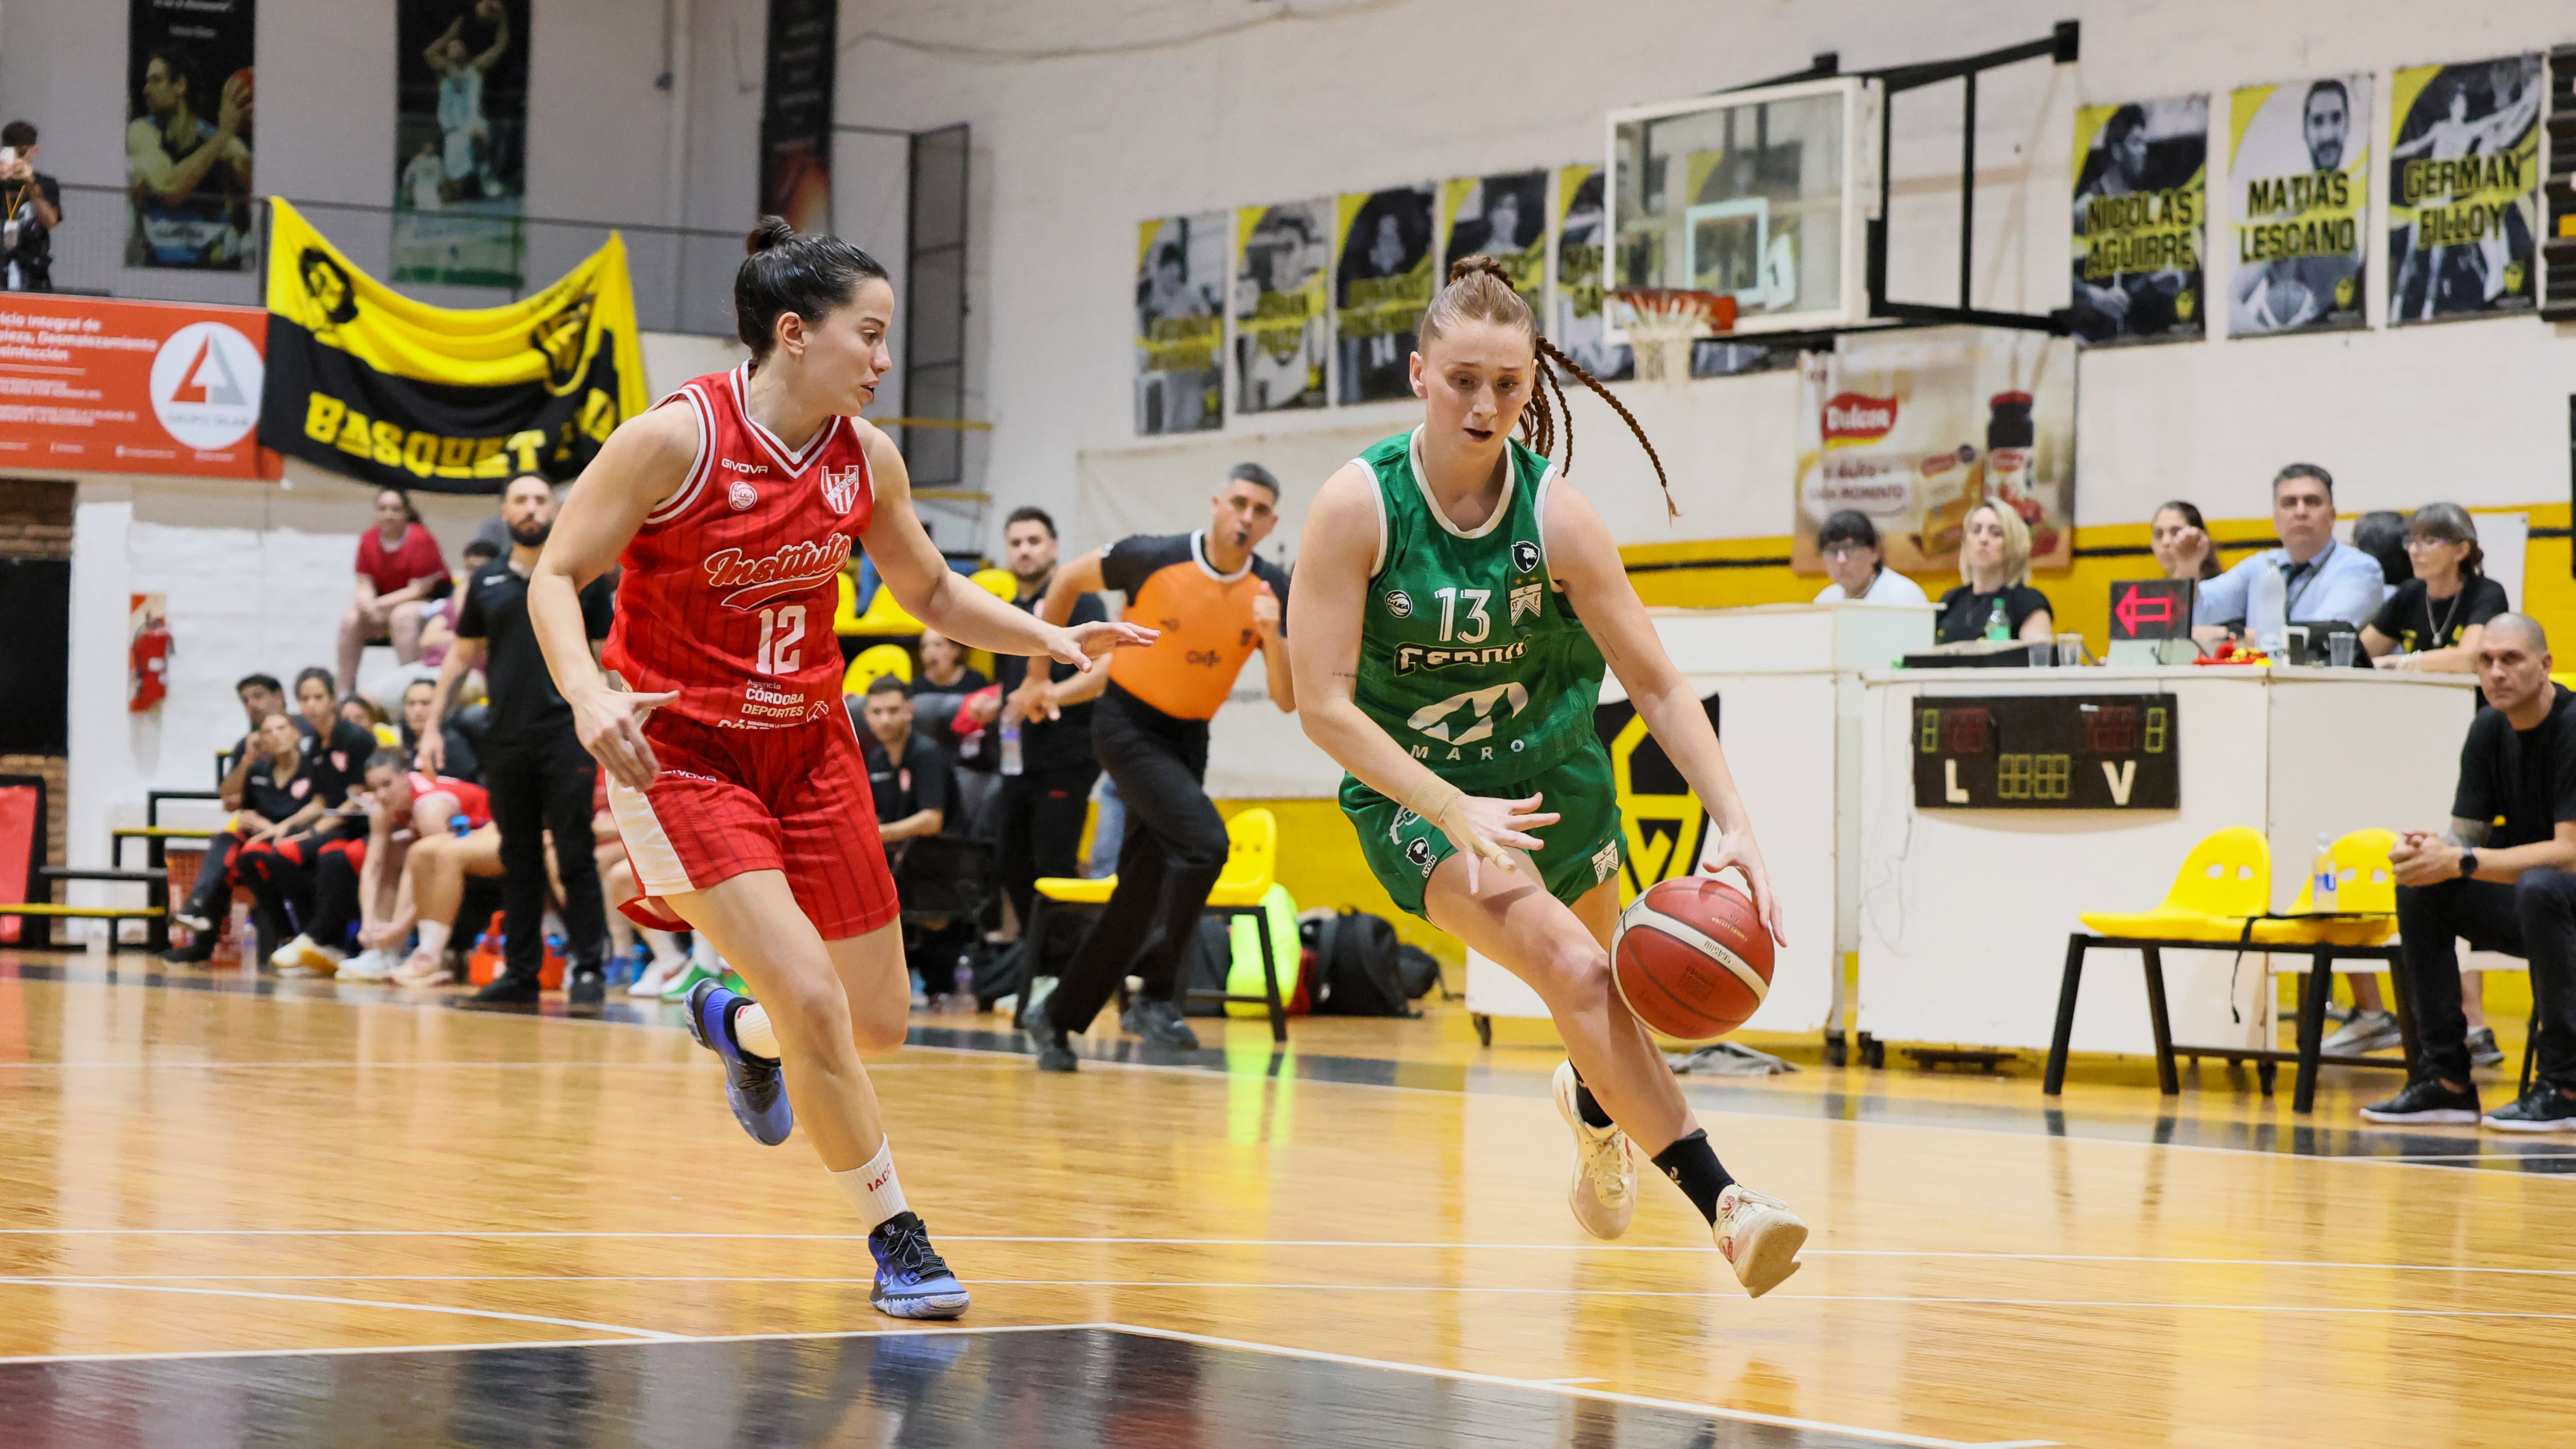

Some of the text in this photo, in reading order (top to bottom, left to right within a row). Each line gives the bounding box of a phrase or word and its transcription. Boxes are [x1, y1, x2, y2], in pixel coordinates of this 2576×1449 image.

[2404, 151, 2521, 204] GERMAN
[2241, 216, 2355, 263] LESCANO
[2419, 203, 2504, 249] FILLOY
[2086, 232, 2194, 278] AGUIRRE
[305, 391, 546, 478] BASQUET
[721, 458, 768, 474] GIVOVA
[1434, 587, 1491, 644] 13
[756, 605, 806, 674] 12
[745, 687, 804, 706] CÓRDOBA
[746, 679, 782, 690] Agencia
[741, 703, 805, 718] DEPORTES
[1945, 759, 1970, 804] L
[2101, 760, 2137, 806] V
[1422, 856, 1436, 877] LYON
[867, 1162, 891, 1192] IACC
